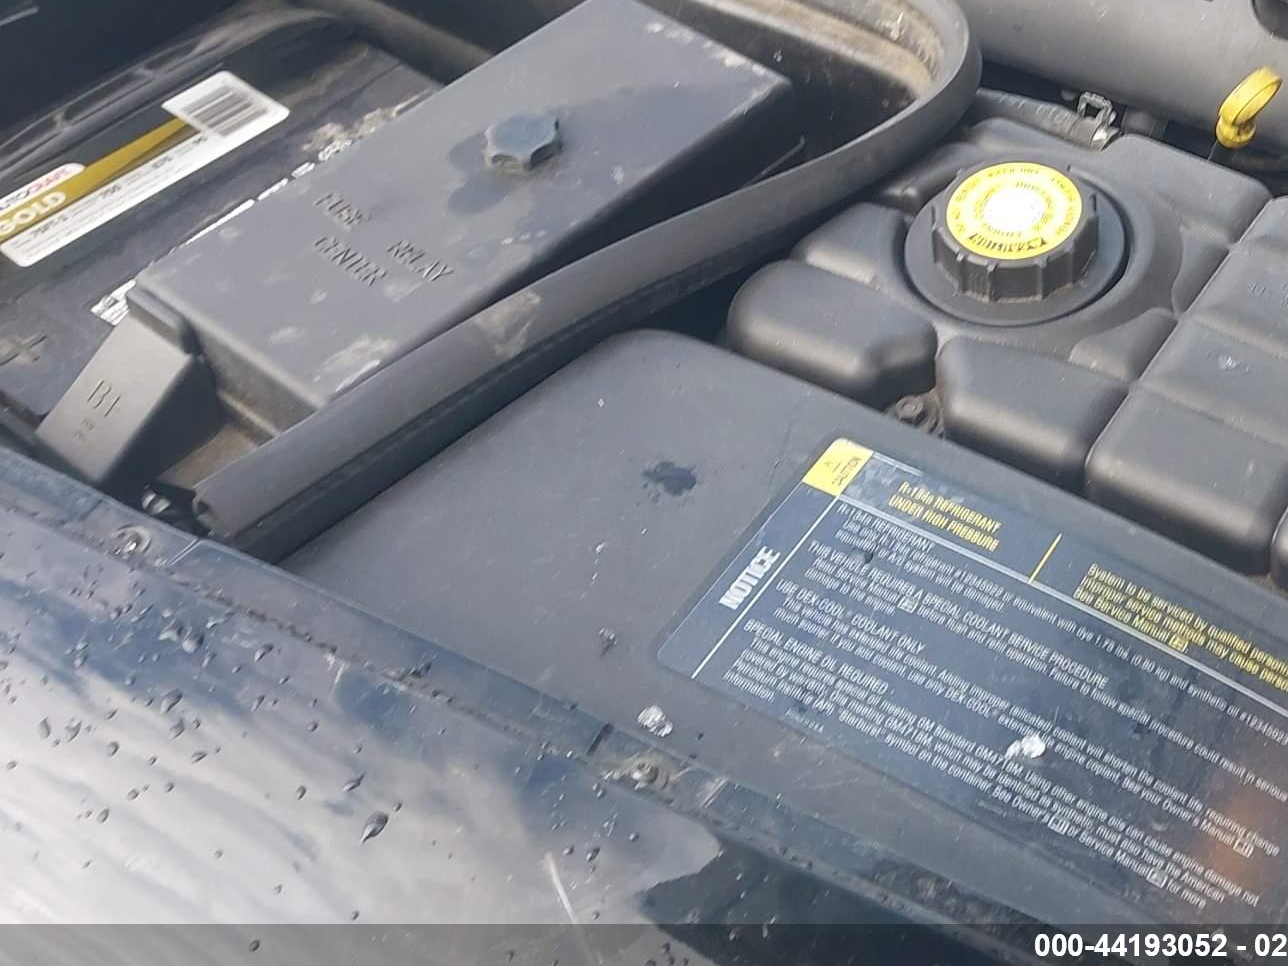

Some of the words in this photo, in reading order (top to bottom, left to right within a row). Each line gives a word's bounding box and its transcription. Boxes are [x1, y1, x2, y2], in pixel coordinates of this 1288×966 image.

[314, 236, 390, 287] CENTER
[870, 517, 935, 553] REFRIGERANT
[885, 493, 925, 518] UNDER
[920, 508, 950, 529] HIGH
[944, 519, 1001, 552] PRESSURE
[932, 496, 1002, 534] REFRIGERANT
[717, 544, 782, 610] NOTICE
[1086, 562, 1126, 590] System
[1149, 594, 1195, 624] serviced
[1206, 622, 1252, 655] qualified
[773, 577, 800, 597] USE
[848, 612, 899, 643] COOLANT
[894, 634, 926, 656] ONLY
[805, 539, 833, 558] THIS
[827, 549, 871, 576] VEHICLE
[865, 566, 917, 598] REQUIRES
[920, 591, 965, 619] SPECIAL
[960, 609, 1011, 641] COOLANT
[1006, 631, 1050, 660] SERVICE
[1047, 650, 1110, 690] PROCEDURE
[1072, 585, 1096, 605] See
[1092, 595, 1134, 624] Service
[1130, 614, 1171, 642] Manual
[1079, 574, 1127, 606] Improper
[1124, 596, 1163, 624] service
[1160, 614, 1207, 646] methods
[1204, 637, 1230, 659] may
[1227, 651, 1260, 675] cause
[741, 617, 788, 646] SPECIAL
[781, 636, 824, 664] ENGINE
[818, 653, 841, 672] OIL
[835, 662, 890, 695] REQUIRED
[747, 636, 772, 653] This
[767, 645, 801, 668] engine
[797, 660, 837, 686] requires
[833, 677, 869, 701] special
[865, 692, 882, 707] oil
[878, 698, 919, 725] meeting
[931, 723, 977, 753] Standard
[1023, 769, 1053, 792] Using
[1049, 783, 1078, 805] other
[1075, 796, 1109, 822] engine
[1106, 813, 1127, 832] oils
[1123, 825, 1144, 842] can
[1142, 835, 1173, 858] cause
[1171, 849, 1206, 875] engine
[1203, 867, 1243, 897] damage
[1241, 888, 1260, 907] not
